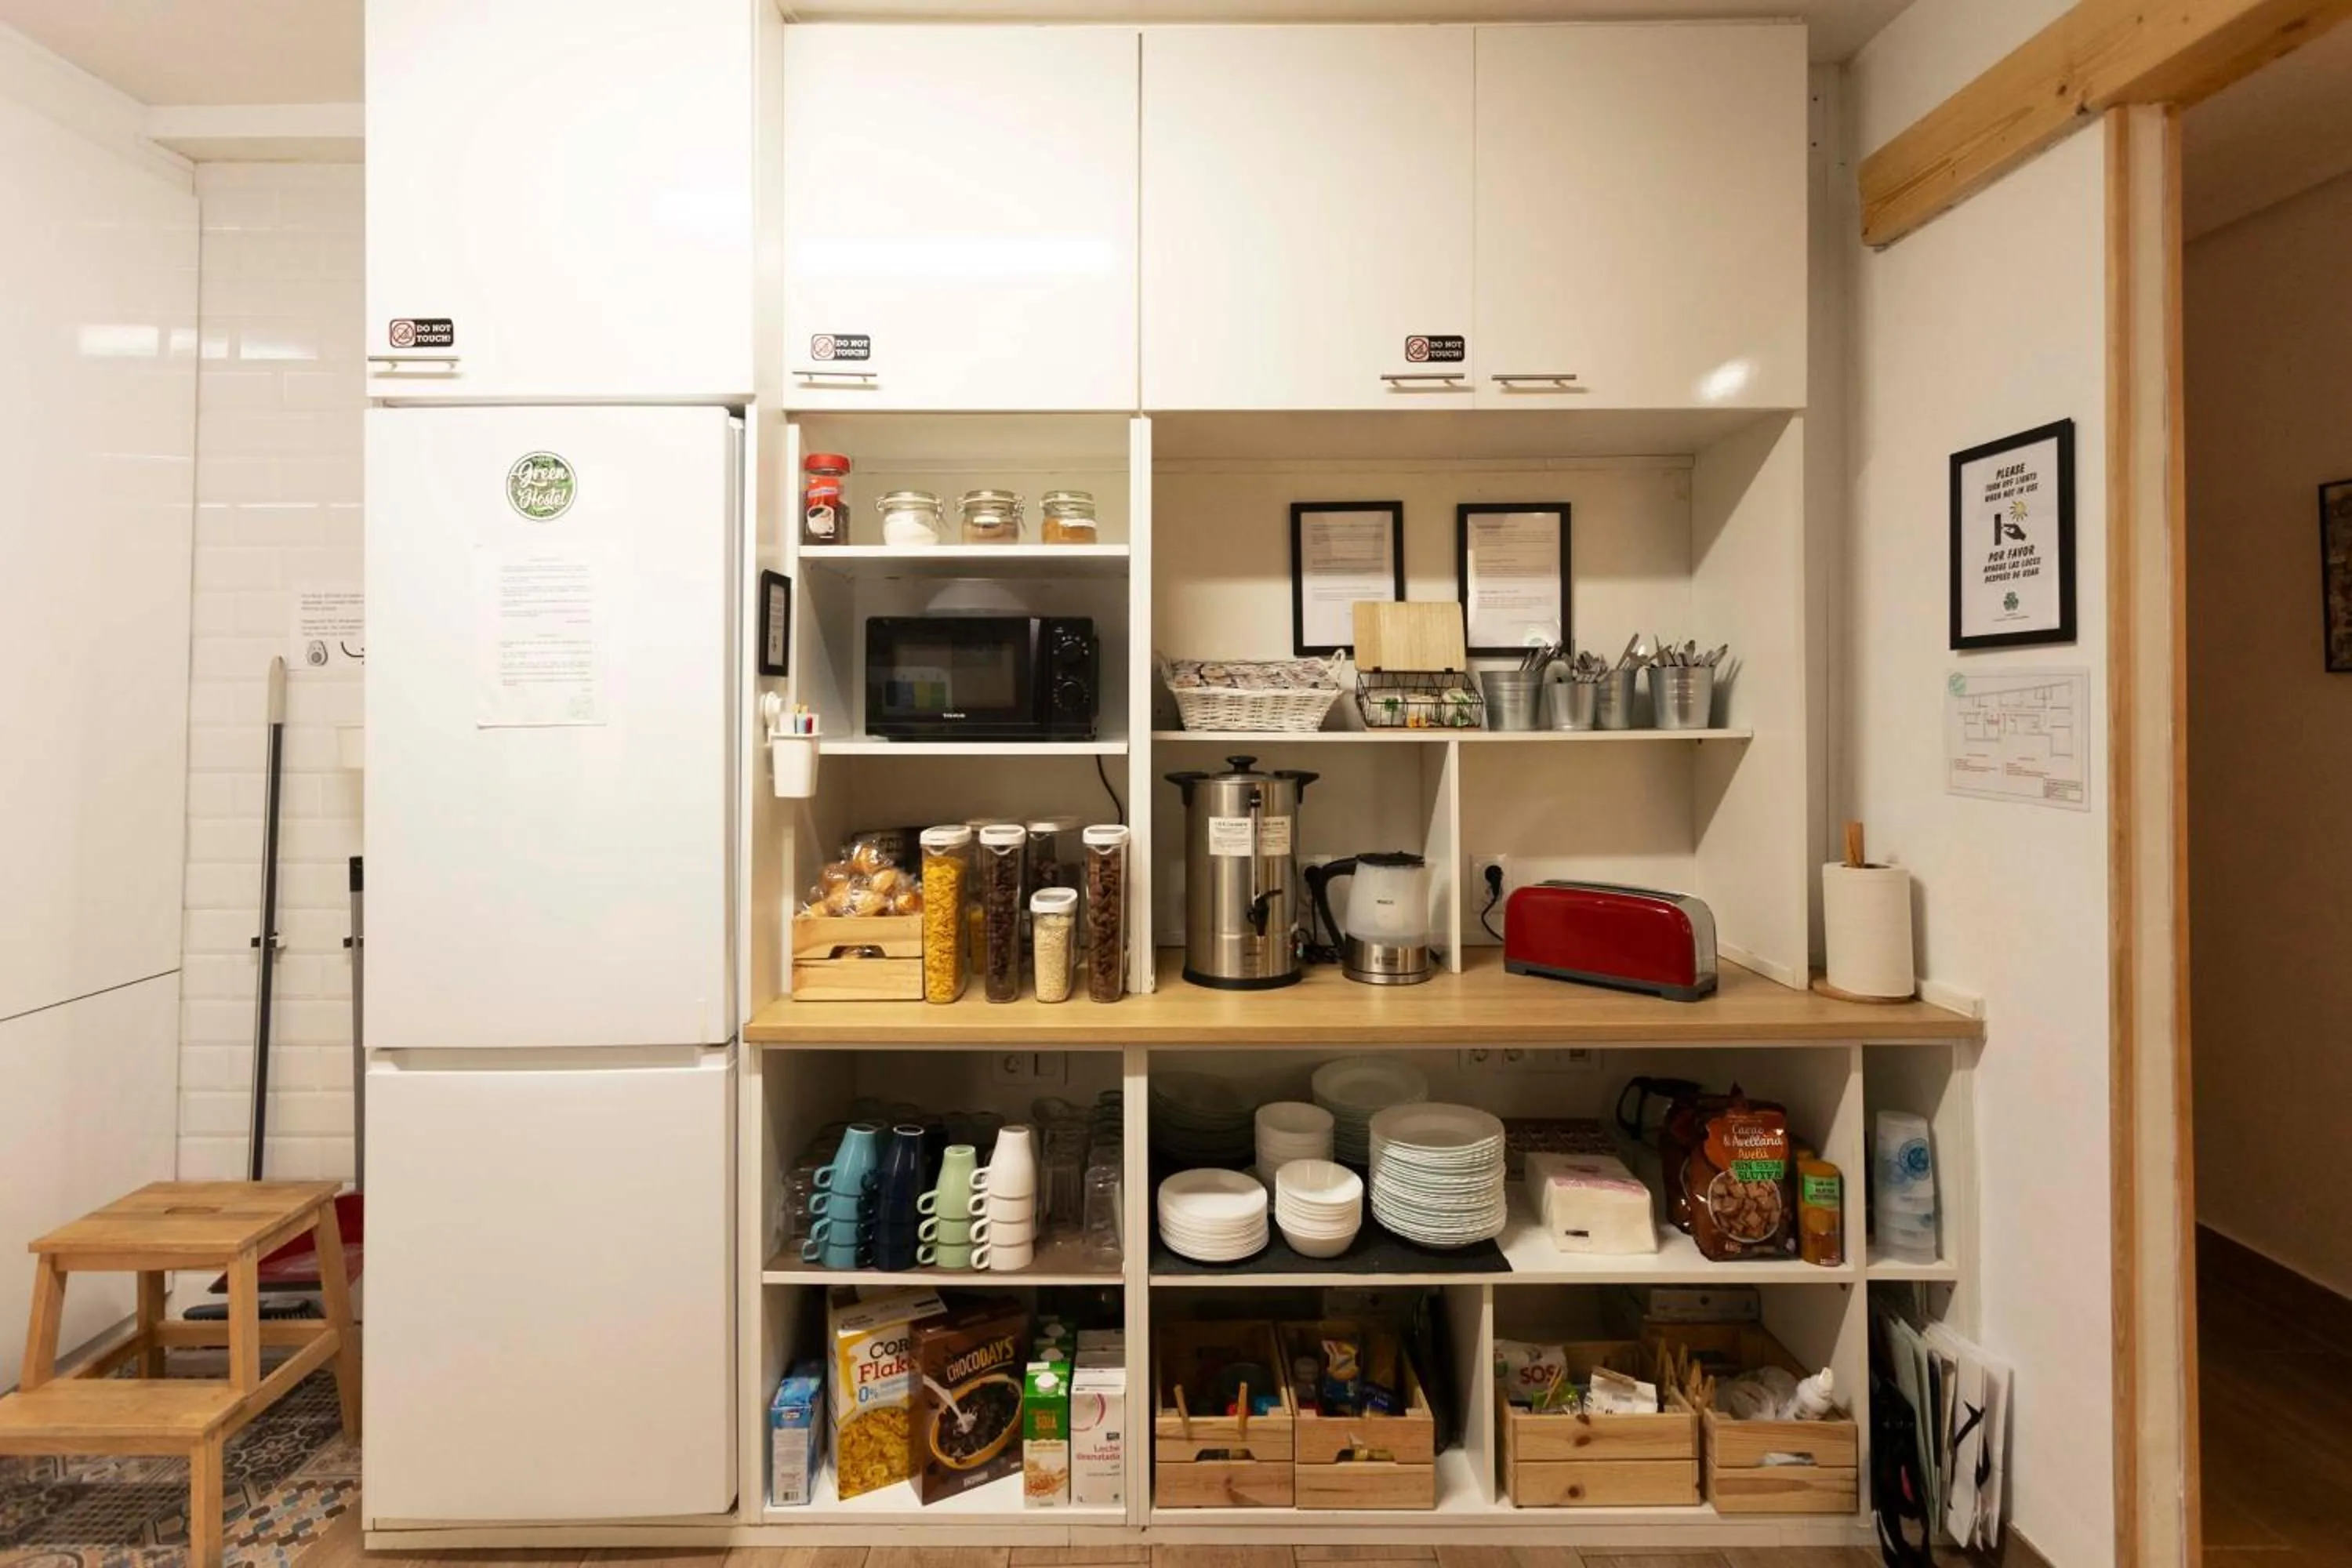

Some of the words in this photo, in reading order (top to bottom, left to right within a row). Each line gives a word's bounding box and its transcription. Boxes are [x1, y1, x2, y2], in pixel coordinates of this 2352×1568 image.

[510, 461, 568, 488] Green
[1996, 463, 2025, 480] PLEASE
[517, 487, 566, 509] Hostel
[1988, 550, 2005, 562] POR
[2007, 545, 2035, 559] FAVOR
[1732, 1134, 1783, 1146] Avellana
[869, 1338, 911, 1359] COR
[946, 1335, 1014, 1383] CHOCODAYS
[858, 1356, 908, 1384] Flak
[1519, 1364, 1555, 1385] SOS
[1094, 1443, 1120, 1453] Leche
